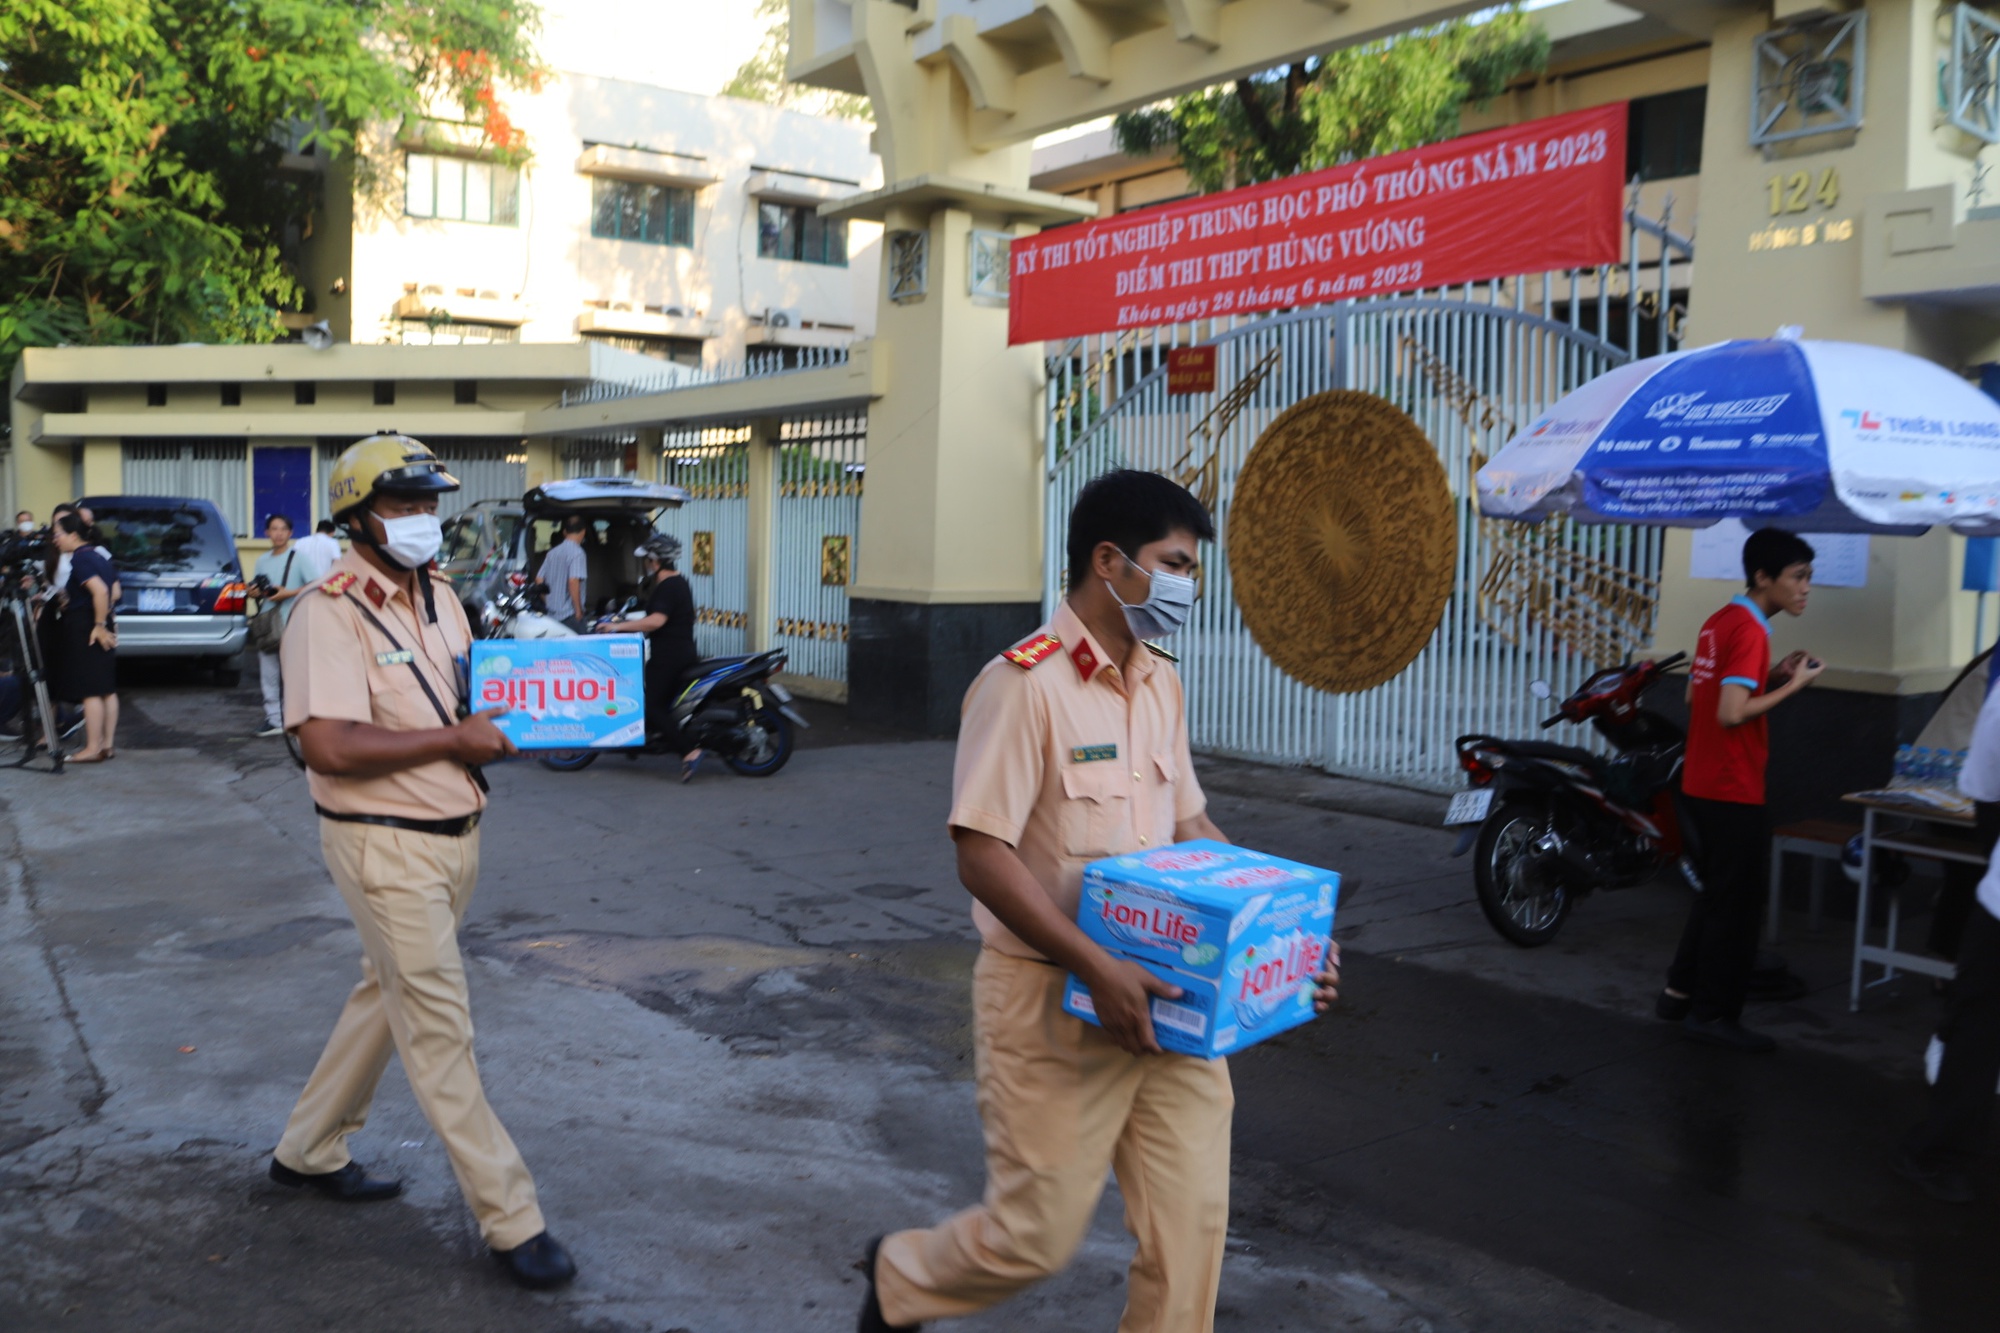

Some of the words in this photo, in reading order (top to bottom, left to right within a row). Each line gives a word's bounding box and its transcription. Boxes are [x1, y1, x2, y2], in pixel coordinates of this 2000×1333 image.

[1042, 243, 1071, 270] THI
[1074, 225, 1109, 264] TỐT
[1111, 214, 1184, 254] NGHIỆP
[1188, 204, 1258, 242] TRUNG
[1263, 191, 1312, 230] HỌC
[1374, 156, 1465, 204] THÔNG
[1472, 142, 1536, 184] NĂM
[1544, 129, 1607, 172] 2023
[1766, 167, 1840, 215] 124
[1167, 257, 1203, 289] THI
[1207, 246, 1262, 284] THPT
[1266, 232, 1333, 272] HÙNG
[1338, 216, 1425, 259] VƯƠNG
[1117, 304, 1163, 327] Khóa
[1164, 296, 1207, 322] ngày
[1212, 291, 1234, 312] 28
[1238, 280, 1297, 307] tháng
[1301, 277, 1314, 297] 6
[1318, 271, 1365, 295] năm
[1373, 261, 1423, 287] 2023
[482, 678, 546, 710] Life
[1151, 907, 1199, 945] Life
